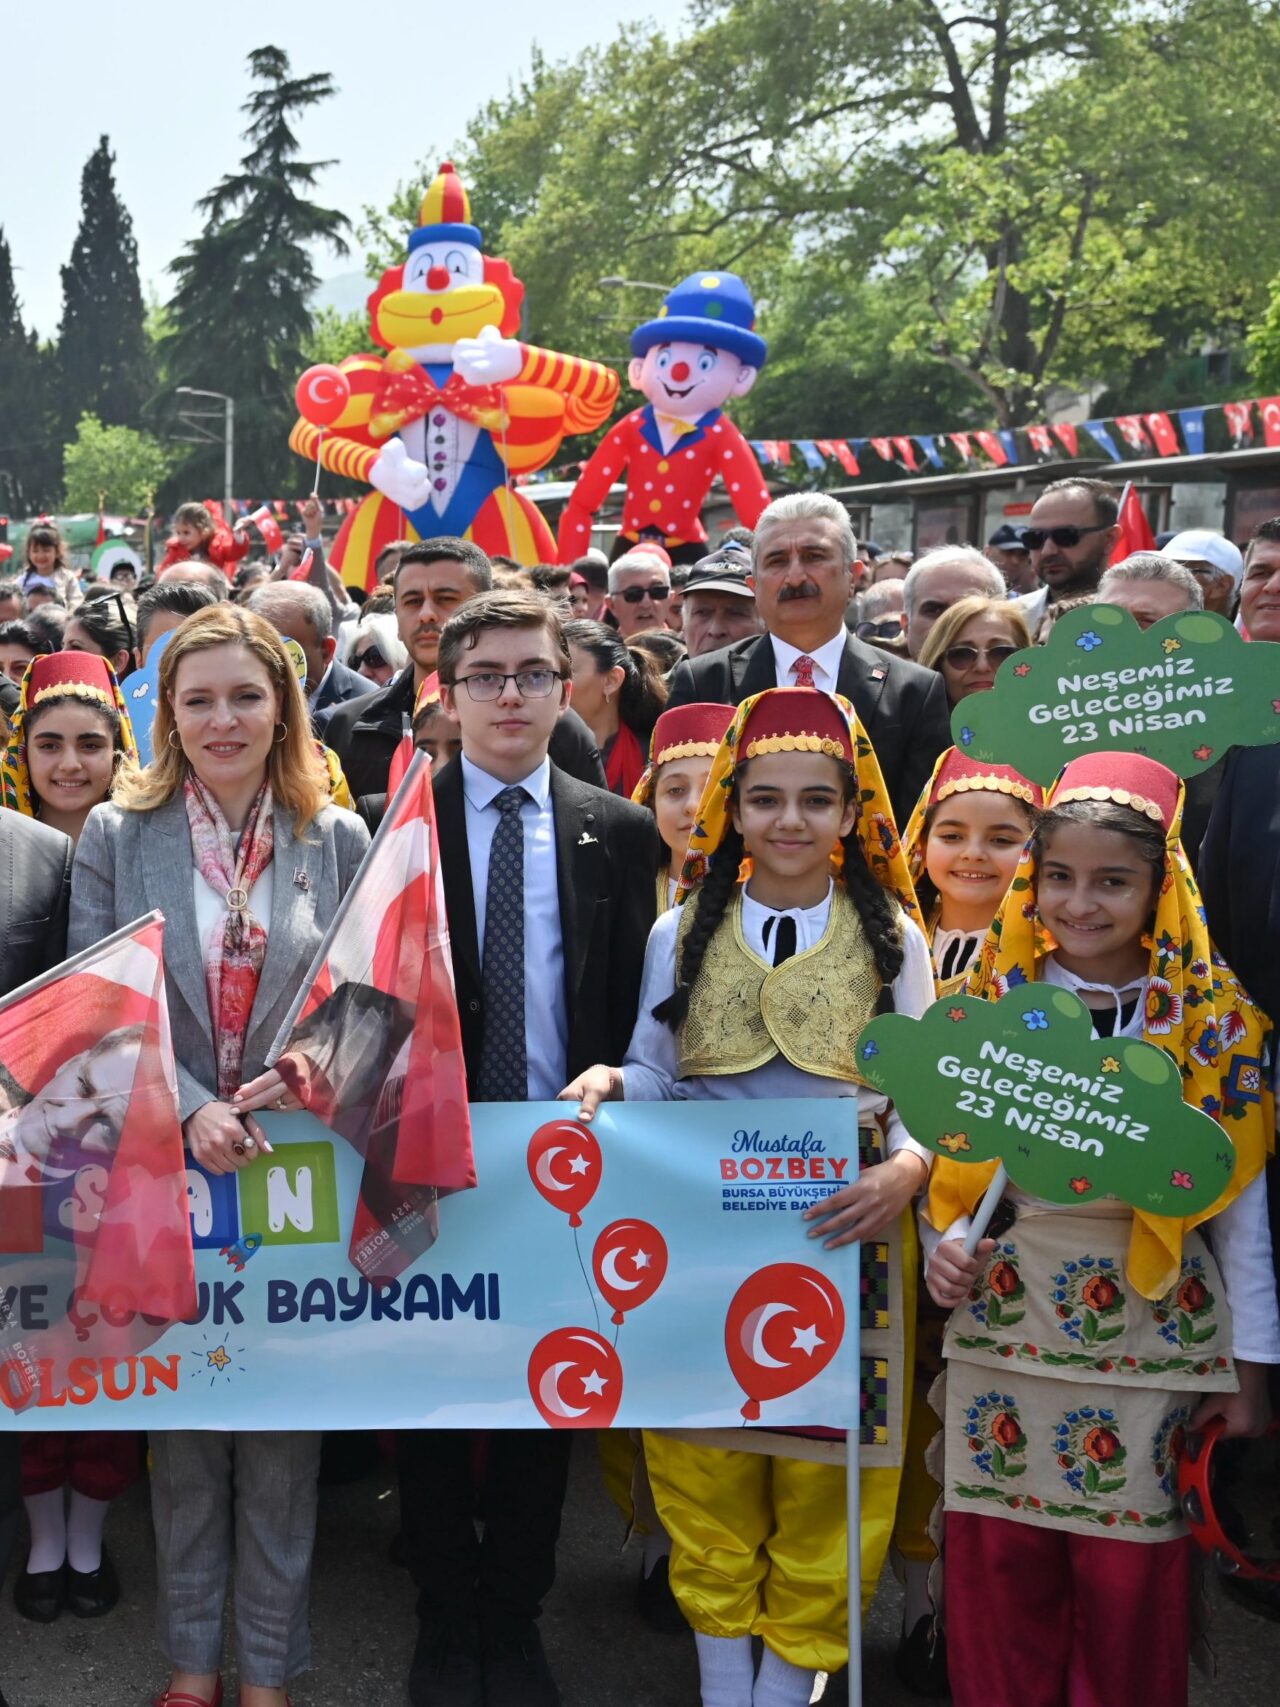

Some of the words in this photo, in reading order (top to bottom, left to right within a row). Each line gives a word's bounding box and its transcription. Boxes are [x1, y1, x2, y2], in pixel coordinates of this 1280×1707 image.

[1057, 657, 1195, 695] Neşemiz
[1028, 676, 1234, 724] Geleceğimiz
[1061, 721, 1099, 744] 23
[1108, 708, 1207, 737] Nisan
[979, 1040, 1124, 1104] Neşemiz
[936, 1055, 1151, 1143] Geleceğimiz
[731, 1129, 826, 1160] Mustafa
[955, 1090, 994, 1119] 23
[1004, 1107, 1105, 1158] Nisan
[720, 1157, 848, 1180] BOZBEY
[722, 1188, 765, 1198] BURSA
[768, 1184, 841, 1200] BÜYÜKŞEHİ
[722, 1198, 787, 1211] BELEDİYE
[66, 1280, 245, 1342] ÇOCUK
[267, 1272, 501, 1324] BAYRAMI
[12, 1341, 41, 1389] BOZBEY
